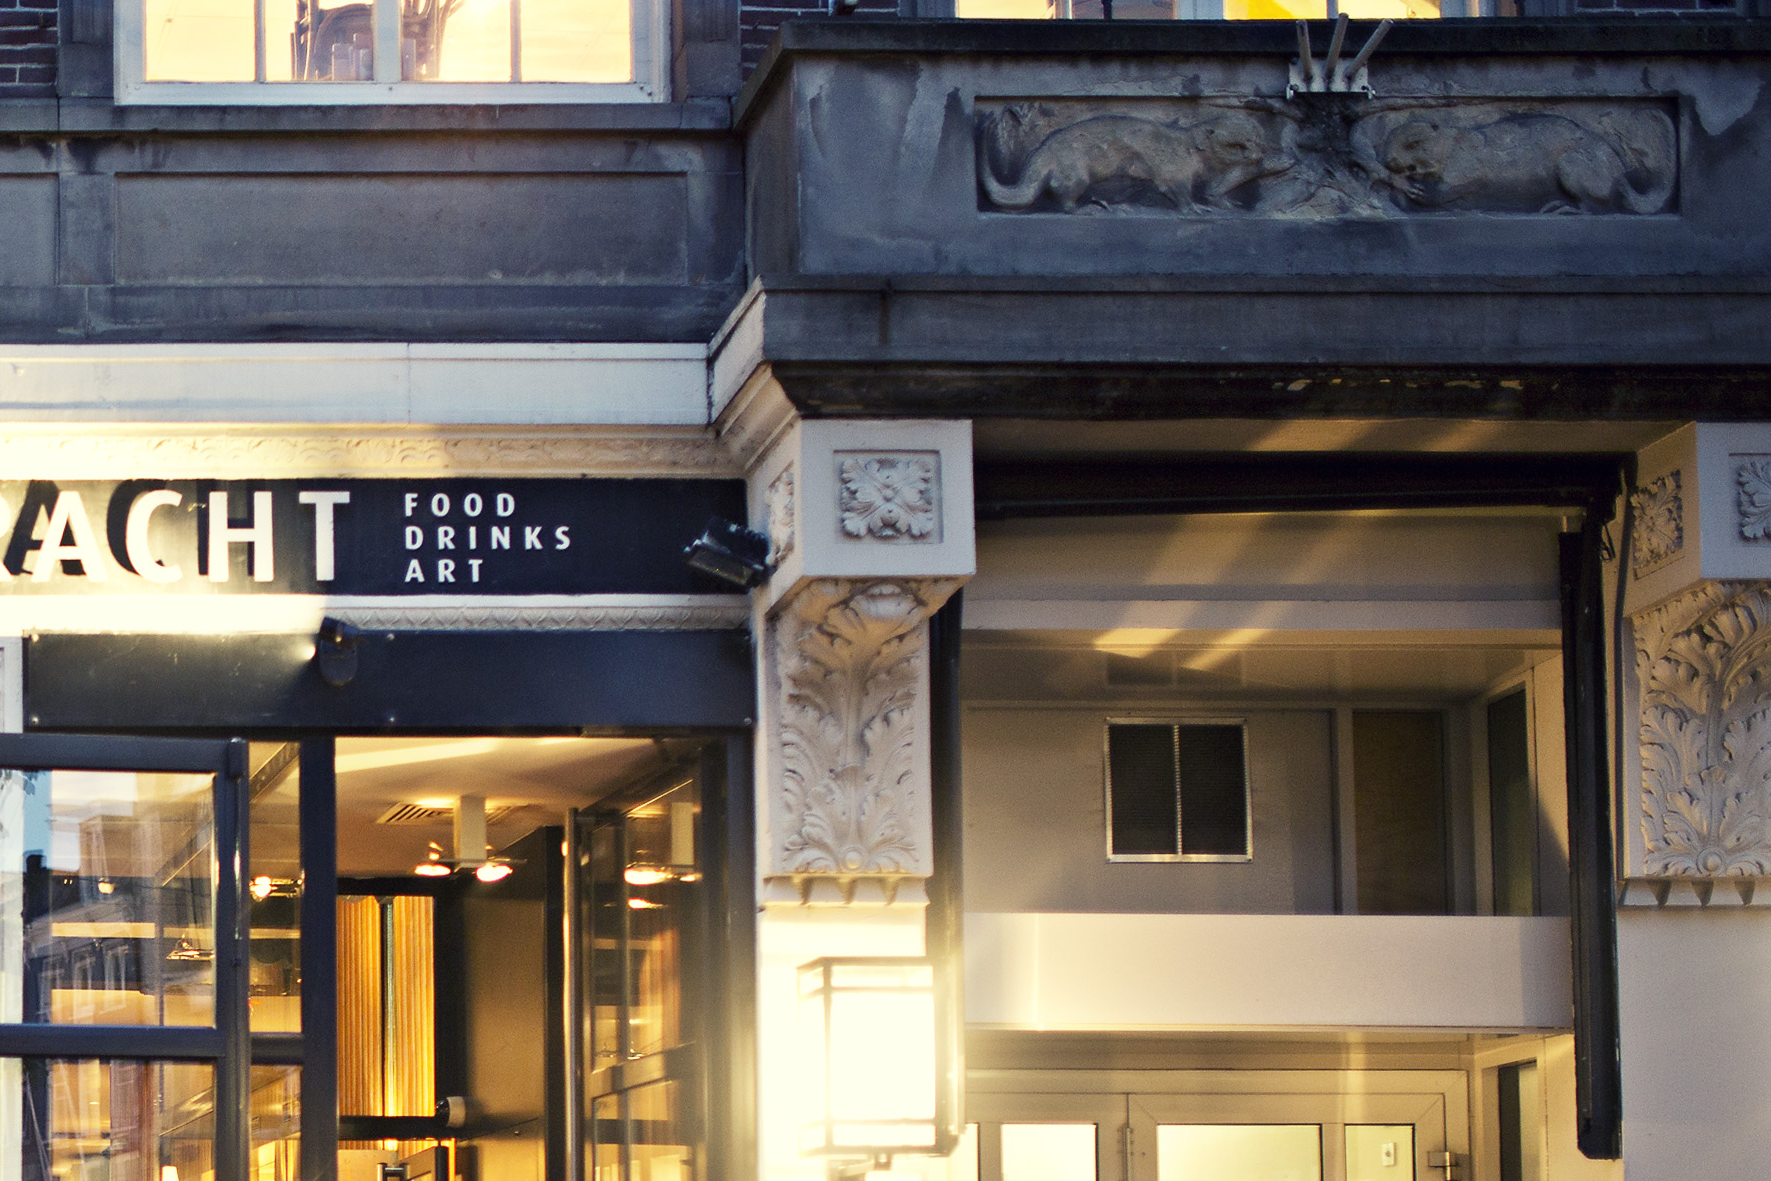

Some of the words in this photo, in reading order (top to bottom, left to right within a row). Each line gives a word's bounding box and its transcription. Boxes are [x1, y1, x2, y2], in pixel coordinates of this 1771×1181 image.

[404, 492, 515, 517] FOOD
[404, 526, 571, 550] DRINKS
[404, 559, 483, 583] ART
